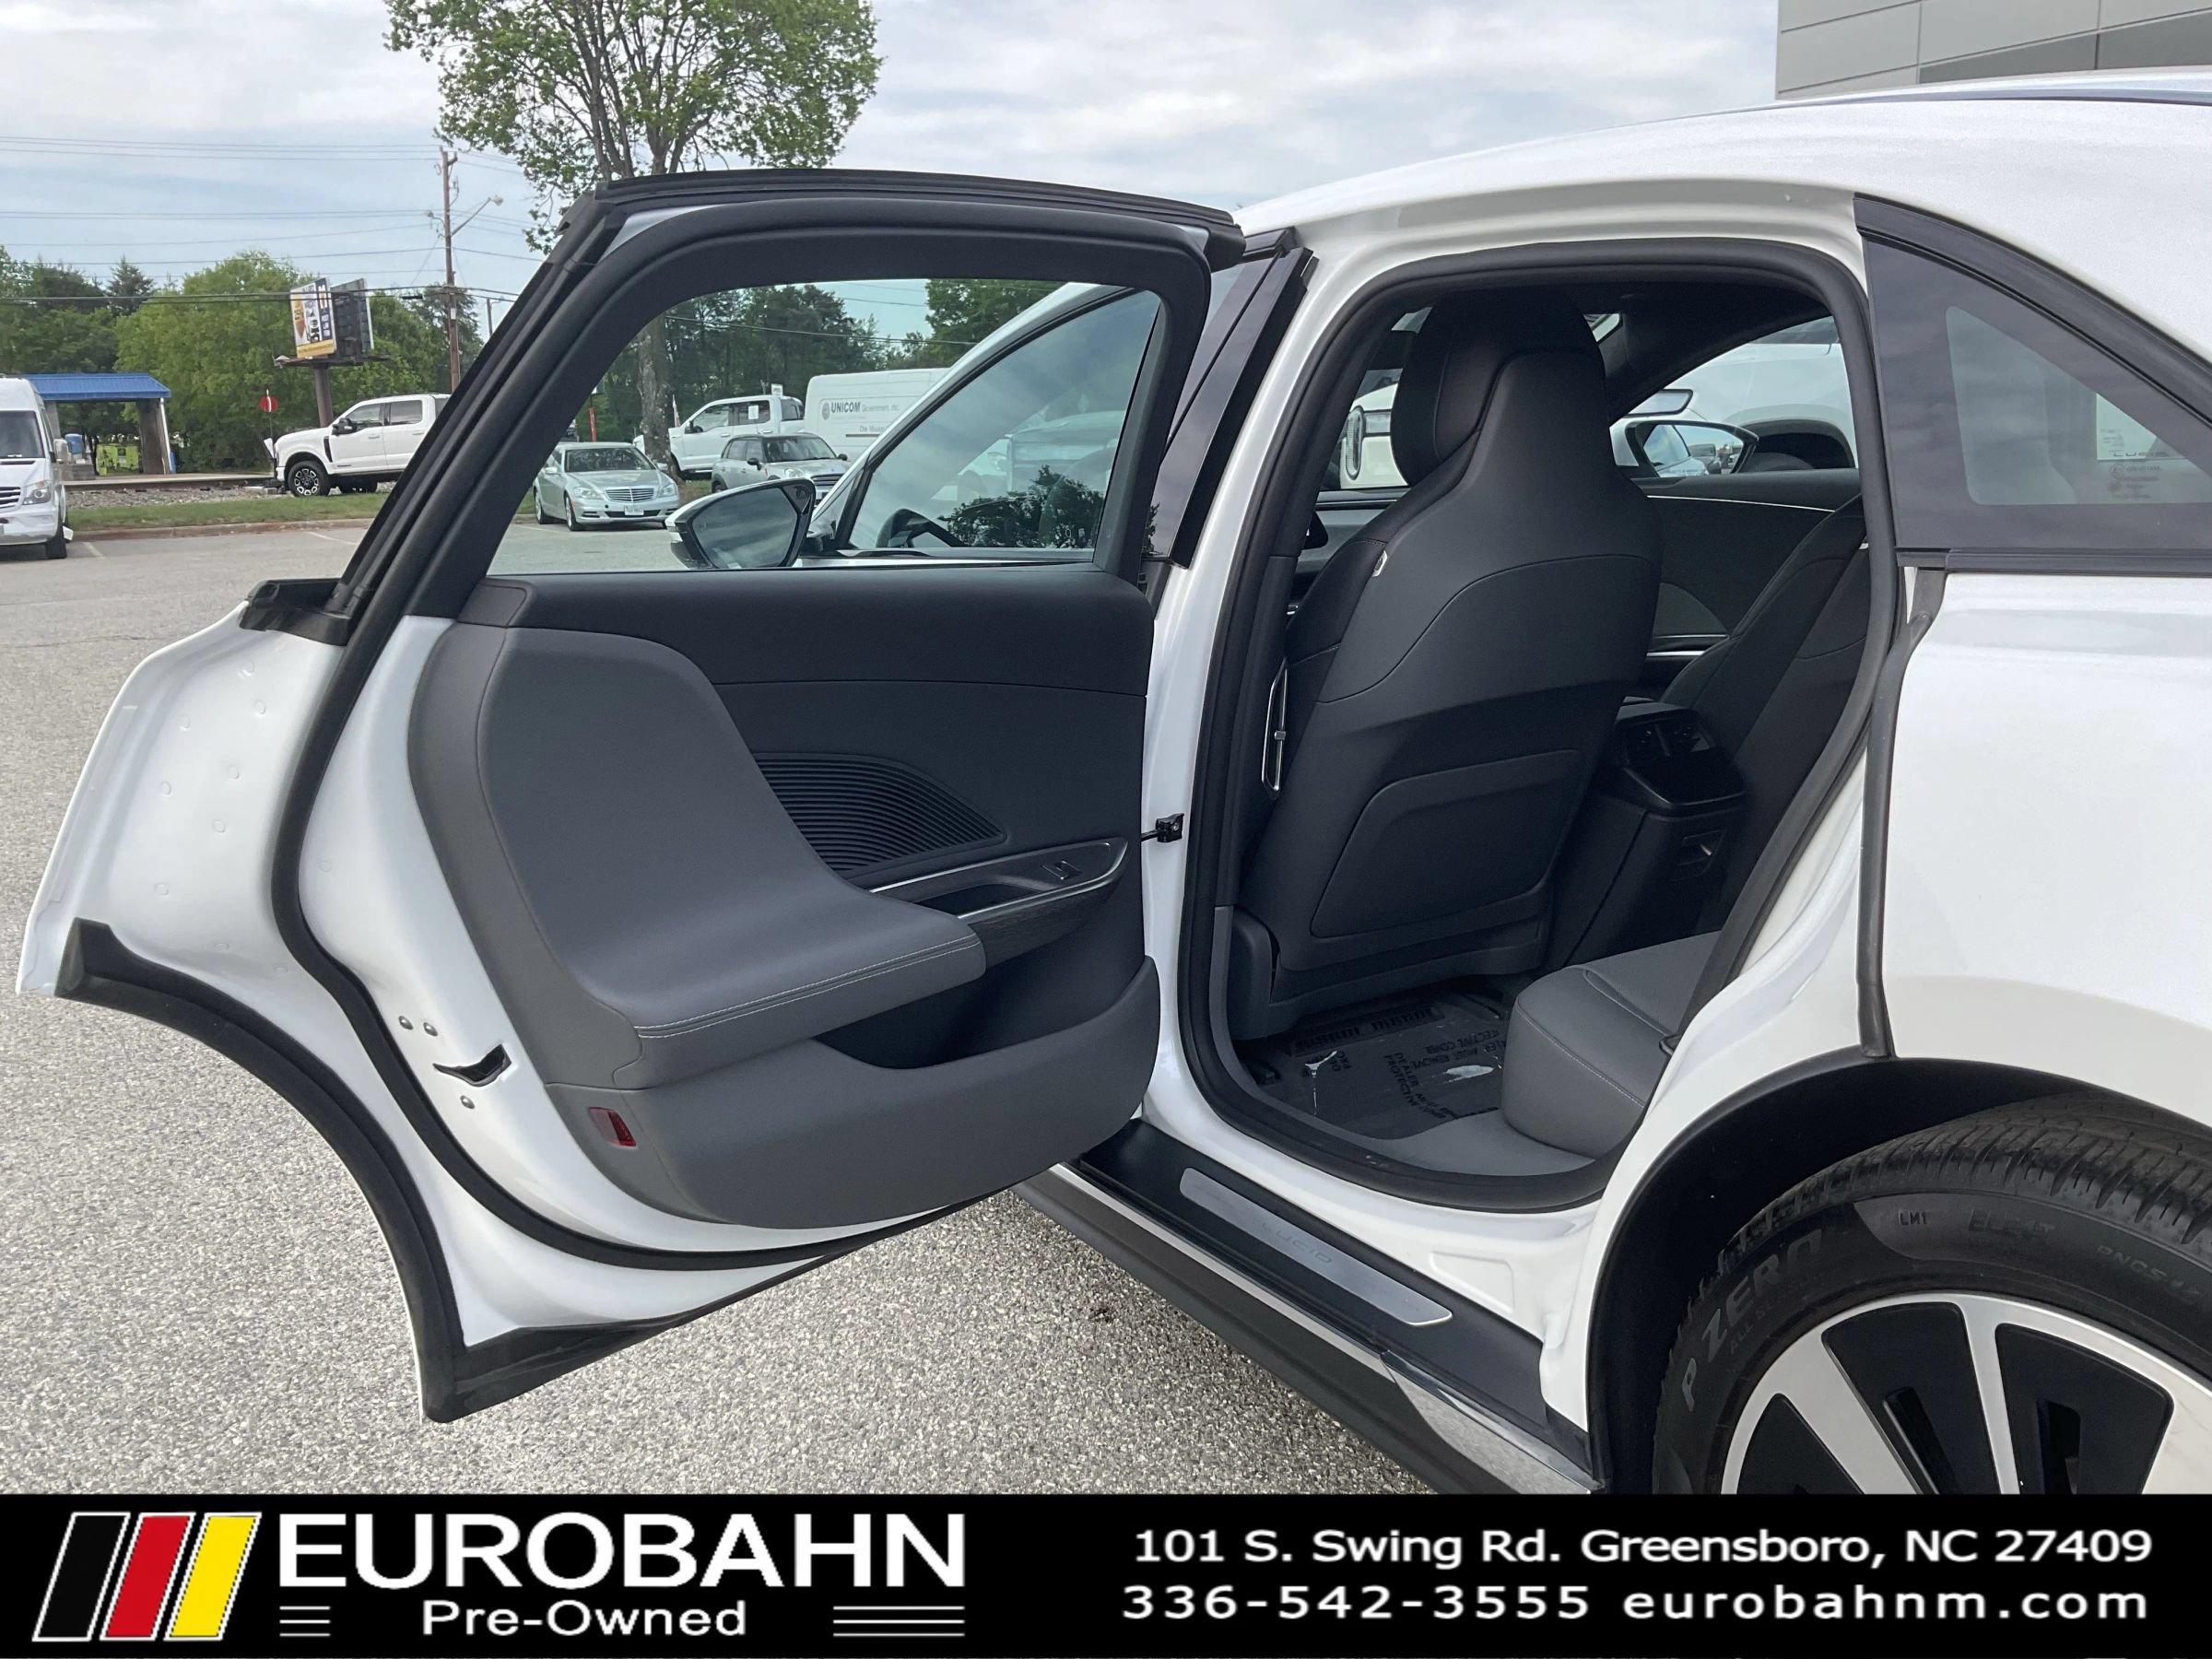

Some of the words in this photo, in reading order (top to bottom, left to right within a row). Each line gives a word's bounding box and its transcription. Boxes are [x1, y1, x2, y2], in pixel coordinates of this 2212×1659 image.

[830, 402, 862, 414] UNICOM
[1899, 1208, 1928, 1227] LM1
[1681, 1358, 1698, 1413] P
